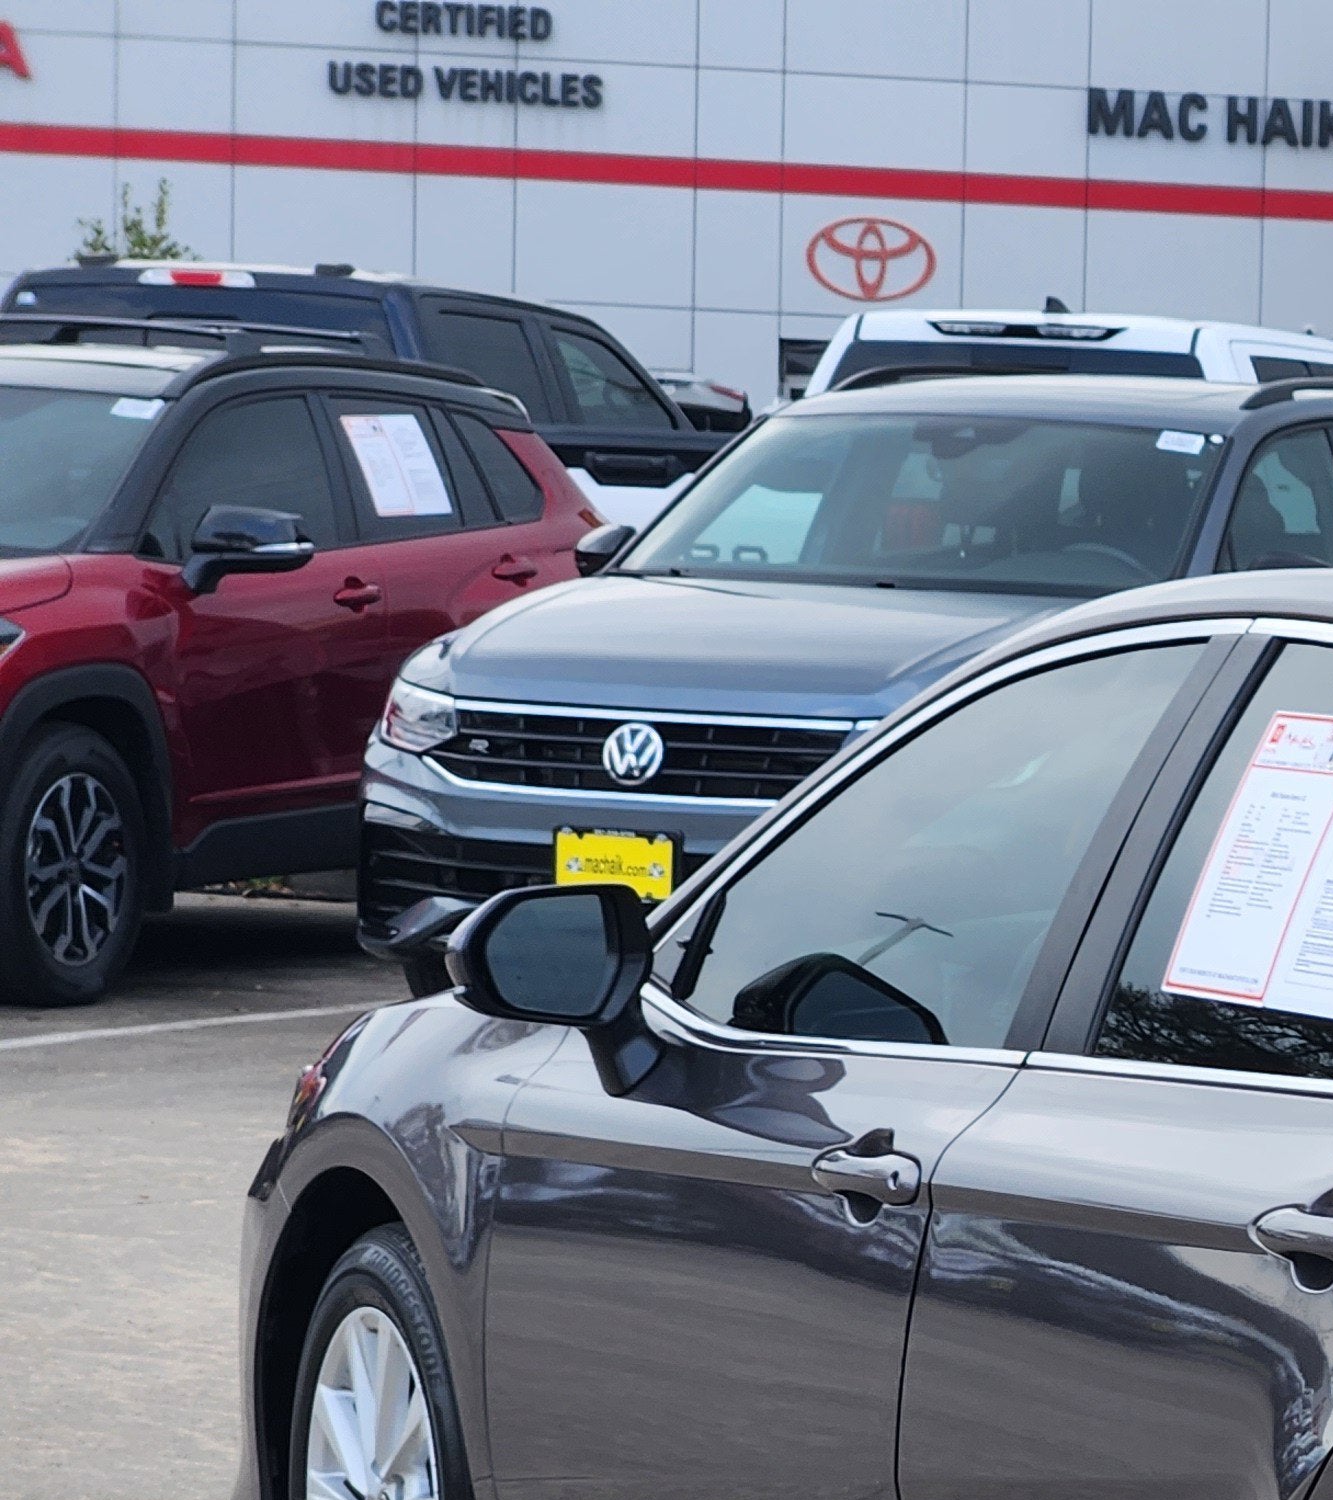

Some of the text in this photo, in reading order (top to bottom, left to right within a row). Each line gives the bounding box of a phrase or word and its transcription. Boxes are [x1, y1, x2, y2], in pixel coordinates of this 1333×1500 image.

[375, 0, 552, 41] CERTIFIED
[328, 60, 604, 109] USED VEHICLES
[1087, 86, 1208, 142] MAC
